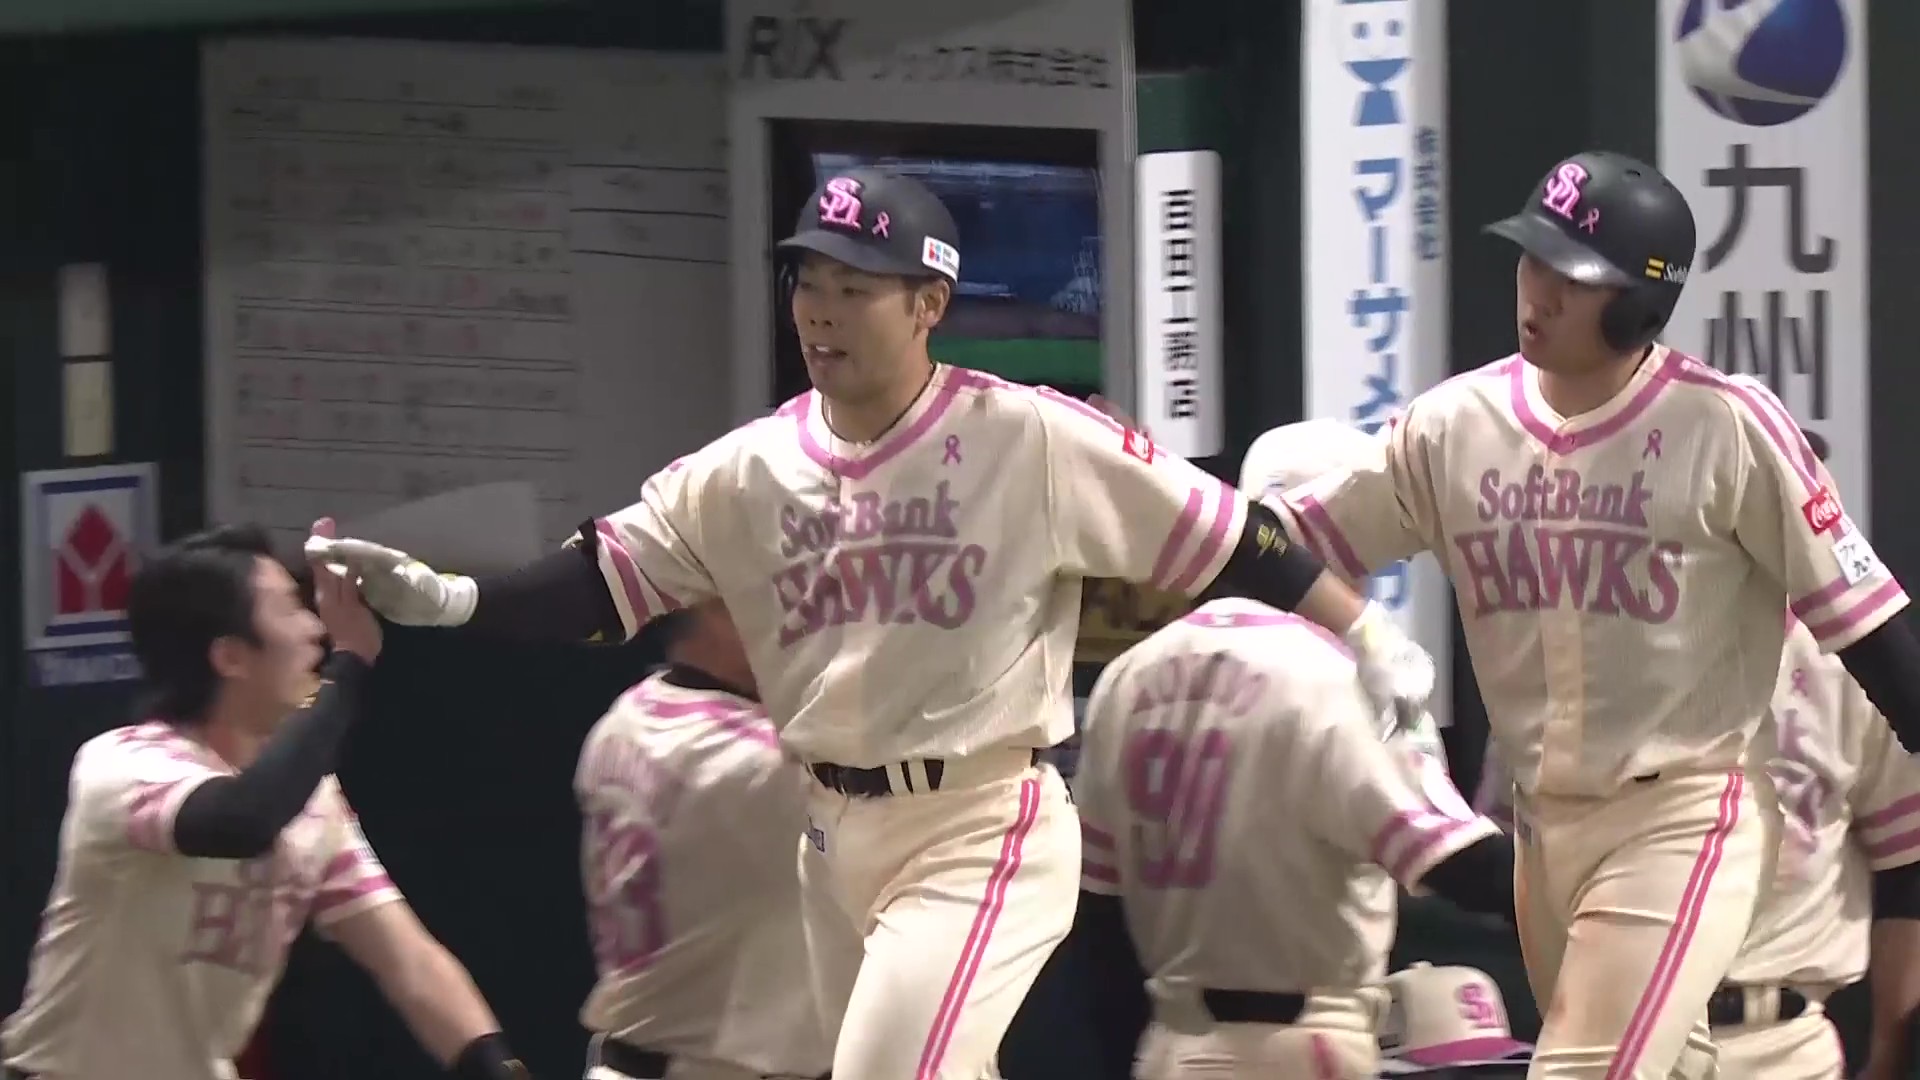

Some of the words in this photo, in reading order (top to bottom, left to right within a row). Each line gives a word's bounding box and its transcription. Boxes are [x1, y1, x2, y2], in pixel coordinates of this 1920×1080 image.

[1700, 143, 1837, 462] 九州
[780, 480, 960, 557] SoftBank
[1478, 464, 1653, 528] SoftBank
[772, 543, 988, 650] HAWKS
[1453, 523, 1683, 625] HAWKS
[1125, 728, 1232, 889] 90
